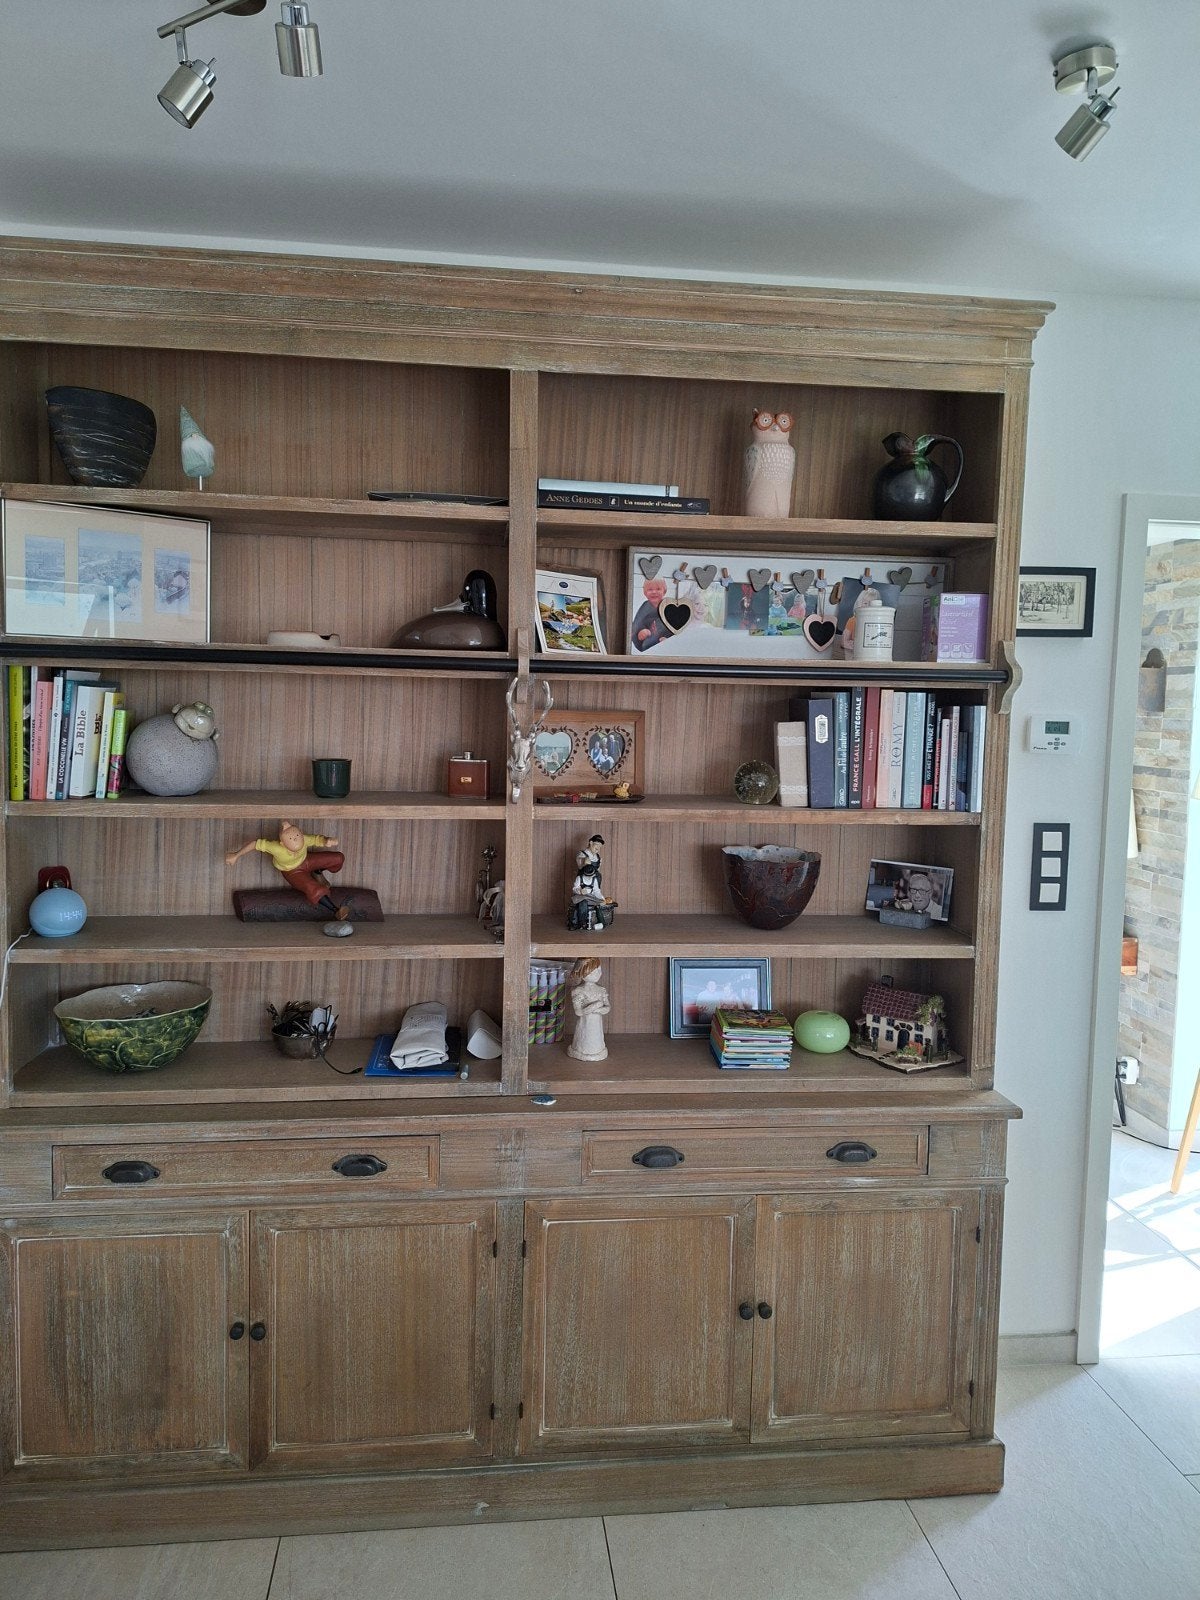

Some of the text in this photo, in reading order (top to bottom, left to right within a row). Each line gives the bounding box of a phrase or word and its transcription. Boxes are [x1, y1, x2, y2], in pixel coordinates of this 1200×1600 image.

[546, 493, 603, 505] ANNE GEDDES
[75, 710, 87, 756] La Bible
[853, 697, 862, 743] L'INTÉGRALE
[891, 722, 903, 767] ROMY
